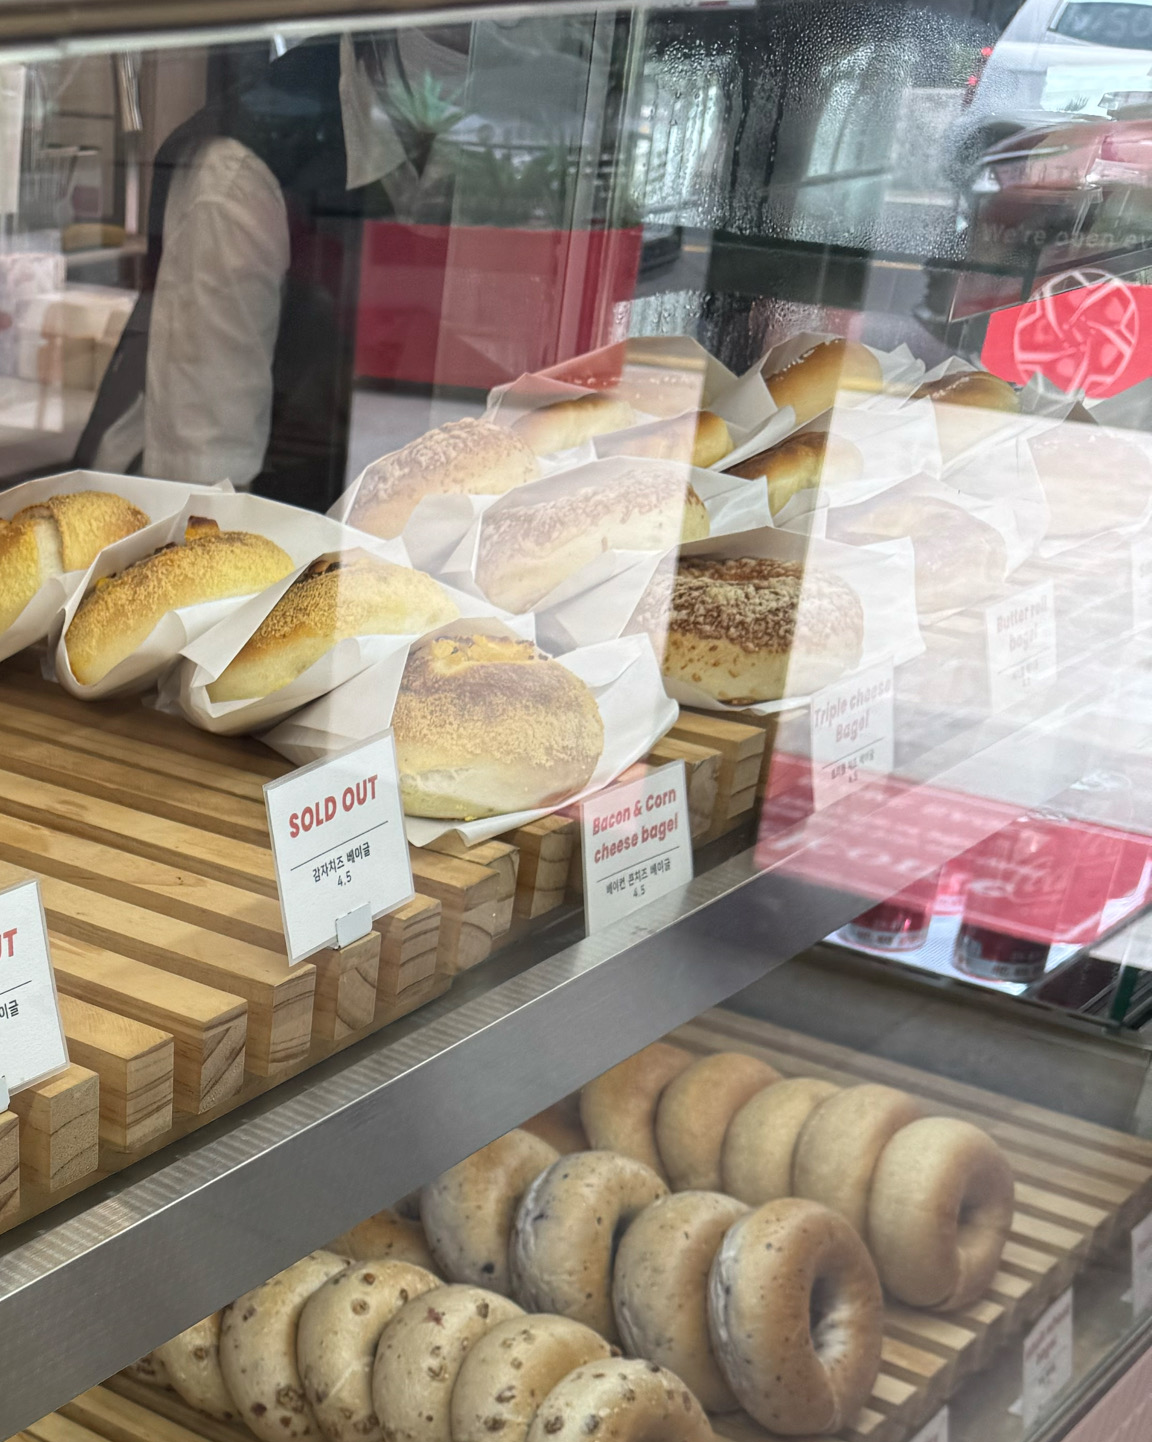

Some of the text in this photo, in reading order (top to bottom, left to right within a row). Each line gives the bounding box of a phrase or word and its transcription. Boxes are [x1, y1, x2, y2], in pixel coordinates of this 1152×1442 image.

[814, 678, 892, 729] Triple cheese
[836, 710, 869, 742] Bagel
[289, 774, 378, 838] SOLD OUT
[592, 788, 677, 836] Bacon & Corn
[594, 812, 679, 864] cheese bagel
[312, 842, 371, 883] 감자치즈 베이글
[337, 871, 352, 887] 4.5
